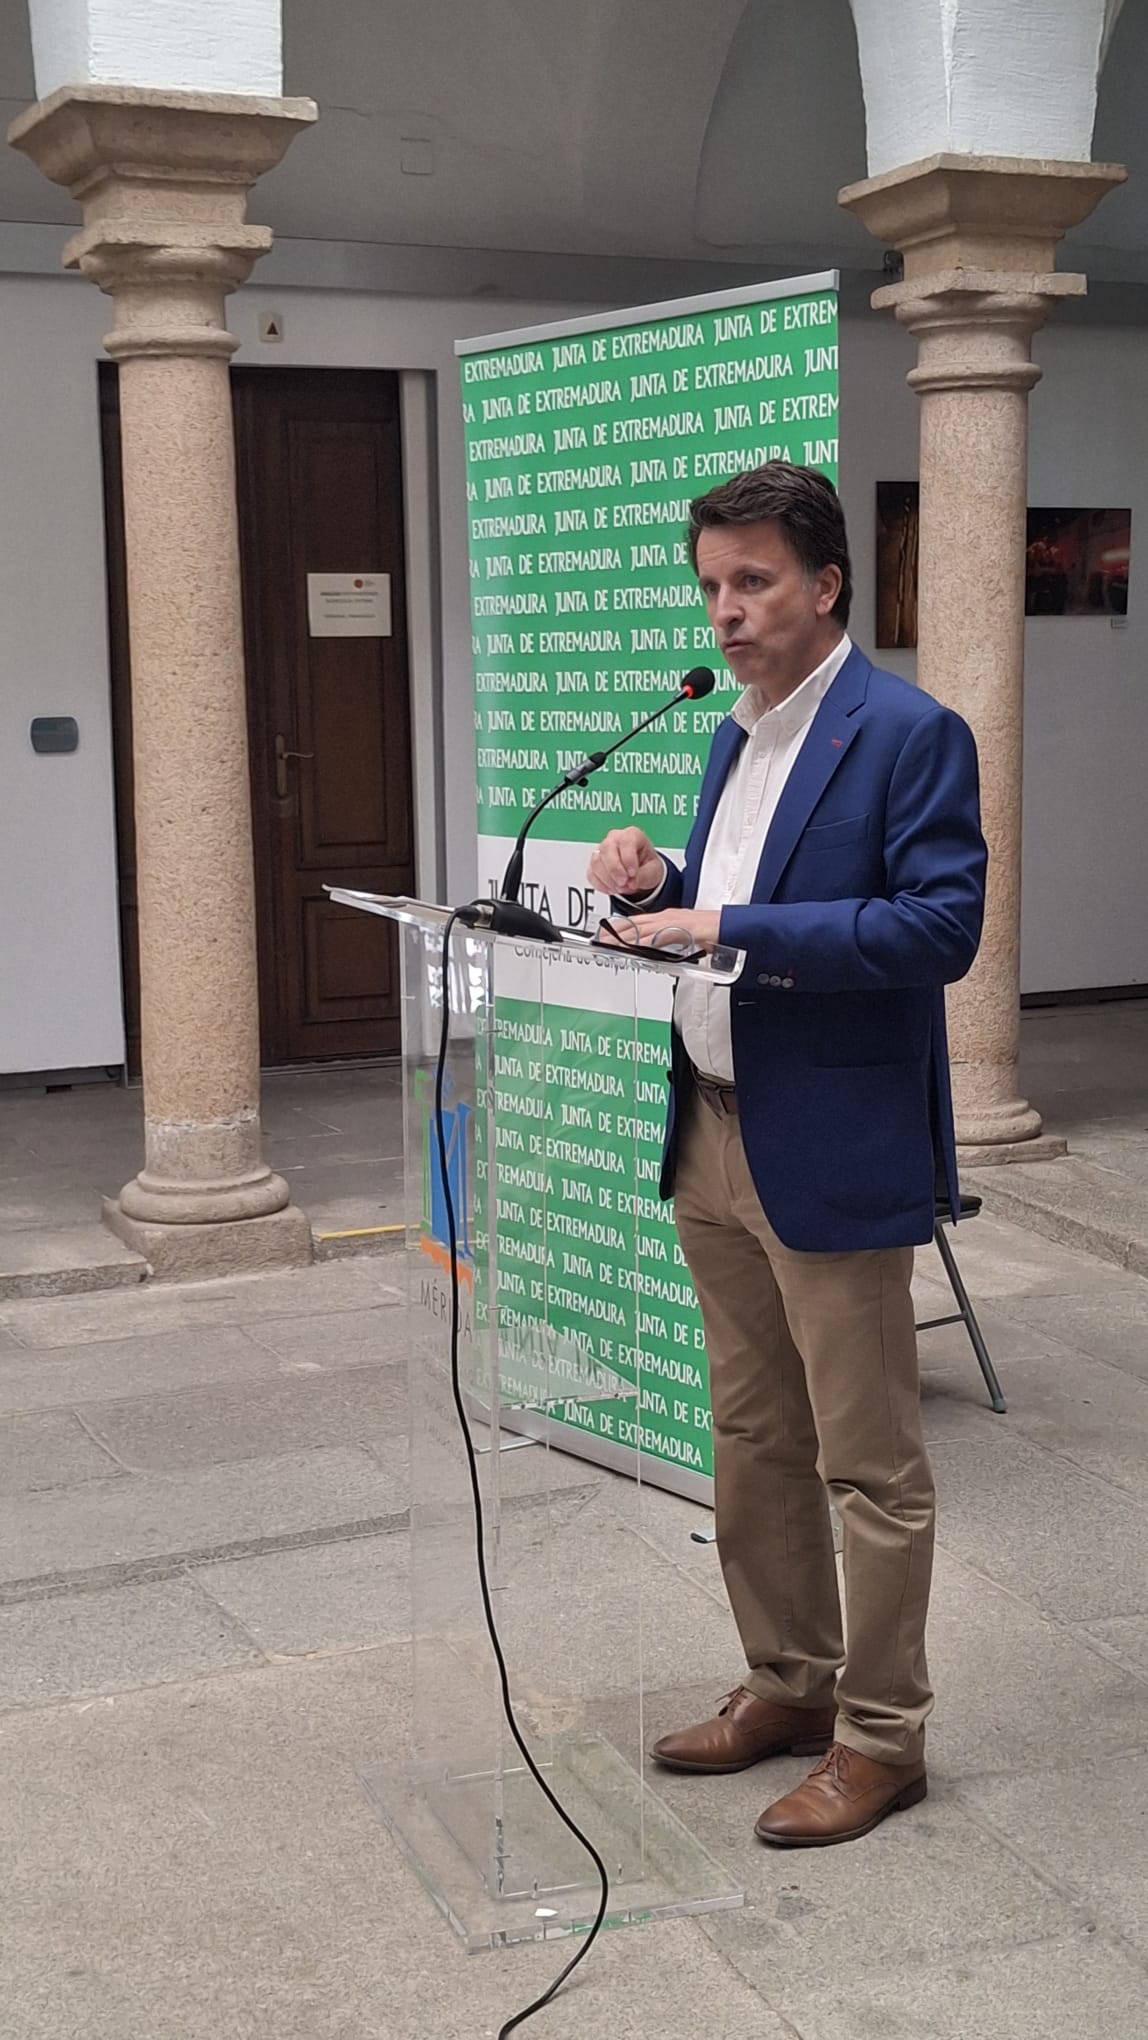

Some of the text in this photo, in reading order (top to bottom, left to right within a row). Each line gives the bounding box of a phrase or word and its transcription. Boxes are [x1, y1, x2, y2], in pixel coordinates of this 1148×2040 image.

[465, 352, 544, 383] EXTREMADURA
[552, 344, 586, 370] JUNTA
[593, 341, 607, 362] DE
[612, 323, 704, 359] EXTREMADURA
[714, 314, 753, 345] JUNTA
[760, 309, 777, 333] DE
[482, 395, 513, 424] JUNTA
[518, 393, 531, 415] DE
[536, 381, 621, 412] EXTREMADURA
[630, 373, 667, 401] JUNTA
[673, 369, 688, 391] DE
[695, 355, 793, 388] EXTREMADURA
[470, 432, 545, 461] EXTREMADURA
[553, 427, 587, 454] JUNTA
[594, 424, 608, 445] DE
[613, 409, 704, 443] EXTREMADURA
[714, 403, 752, 434] JUNTA
[760, 400, 776, 423] DE
[484, 477, 513, 502] JUNTA
[518, 474, 531, 494] DE
[537, 465, 621, 492] EXTREMADURA
[630, 459, 667, 486] JUNTA
[673, 456, 688, 478] DE
[472, 500, 692, 539] EXTREMADURA JUNTA DE EXTREMADUR
[486, 556, 513, 580] JUNTA
[519, 554, 533, 575] DE
[538, 547, 621, 574] EXTREMADURA
[630, 544, 667, 570] JUNTA
[673, 543, 687, 565] DE
[474, 584, 703, 616] EXTREMADURA JUNTA DE EXTREMADURA
[487, 634, 515, 655] JUNTA
[520, 633, 534, 653] DE
[539, 631, 621, 652] EXTREMADURA
[631, 628, 667, 653] JUNTA
[673, 627, 687, 648] DE
[476, 670, 745, 694] EXTREMADURA JUNTA DE EXTREMADU JUN
[488, 711, 515, 732] JUNTA
[521, 710, 534, 730] DE
[540, 711, 622, 732] EXTREMADURA
[631, 711, 667, 734] JUNTA
[674, 712, 688, 732] DE
[477, 749, 548, 769] EXTREMADURA
[614, 753, 701, 774] EXTREMADURA
[488, 787, 516, 808] JUNTA
[522, 788, 535, 807] DE
[631, 794, 667, 816] JUNTA
[673, 795, 688, 816] DE
[560, 1029, 592, 1053] JUNTA
[598, 1035, 611, 1057] DE
[616, 1039, 672, 1067] EXTREMA
[494, 1055, 523, 1078] JUNTA
[529, 1061, 542, 1082] DE
[545, 1064, 624, 1098] EXTREMADURA
[634, 1080, 667, 1106] UNTA
[561, 1104, 593, 1129] JUNTA
[598, 1111, 612, 1133] DE
[495, 1127, 524, 1151] JUNTA
[529, 1135, 542, 1155] DE
[546, 1138, 625, 1174] EXTREMADURA
[634, 1157, 661, 1183] UNT
[562, 1178, 594, 1204] JUNTA
[599, 1187, 613, 1209] DE
[496, 1199, 526, 1224] JUNTA
[530, 1207, 543, 1228] DE
[547, 1211, 626, 1251] EXTREMADURA
[634, 1233, 667, 1262] UNTA
[562, 1252, 594, 1279] JUNTA
[600, 1263, 613, 1285] DE
[497, 1270, 526, 1296] JUNTA
[531, 1280, 544, 1301] DE
[548, 1284, 626, 1327] EXTREMADURA
[635, 1311, 668, 1340] UNTA
[674, 1322, 689, 1345] DE
[563, 1326, 594, 1354] JUNTA
[600, 1338, 613, 1360] DE
[618, 1344, 703, 1390] EXTREMADURA
[635, 1389, 668, 1417] UNTA
[674, 1400, 689, 1423] DE
[600, 1413, 614, 1436] DE
[619, 1420, 703, 1467] EXTREMADURA
